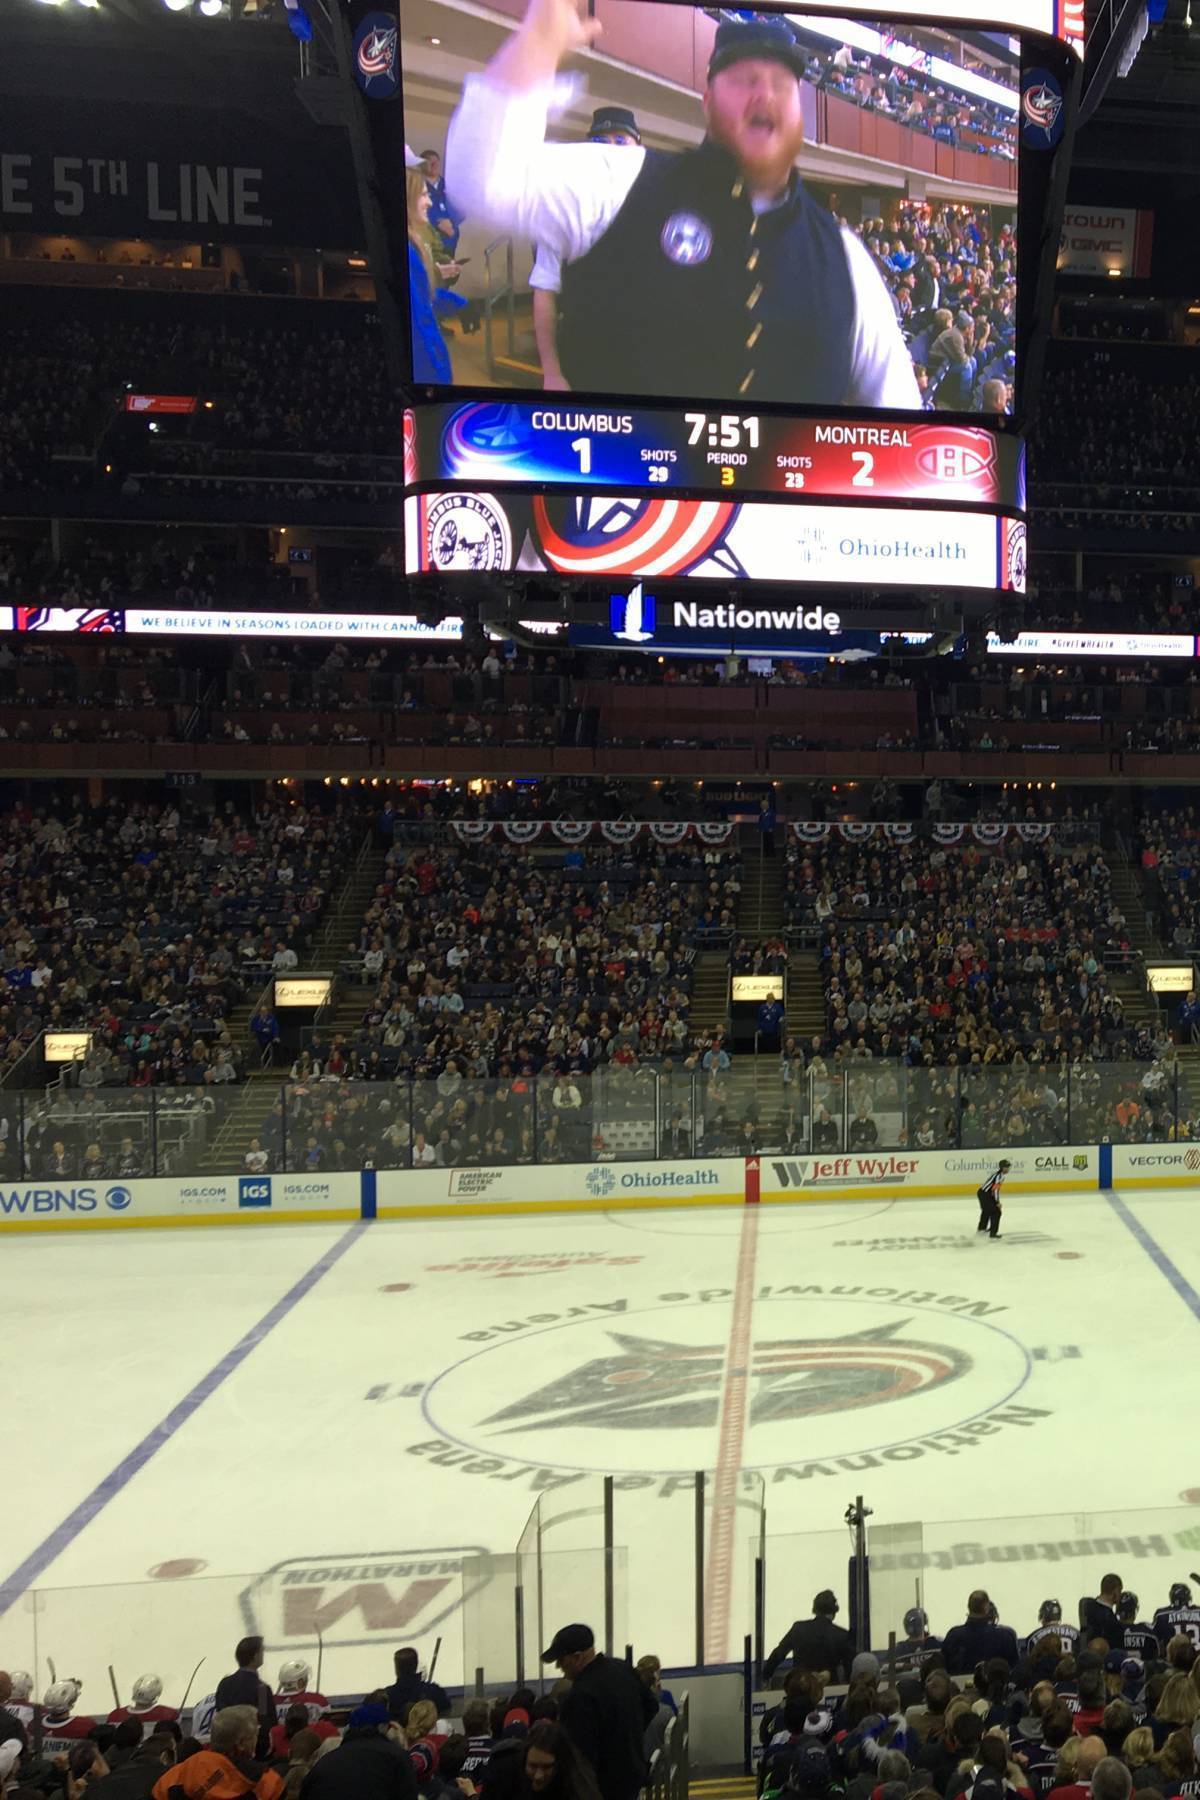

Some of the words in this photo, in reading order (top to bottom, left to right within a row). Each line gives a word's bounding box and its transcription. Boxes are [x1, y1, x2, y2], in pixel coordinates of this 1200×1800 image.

[147, 162, 264, 227] LINE
[531, 411, 633, 433] COLUMBUS
[684, 412, 760, 449] 7:51
[815, 425, 912, 448] MONTREAL
[571, 437, 592, 474] 1
[851, 450, 875, 487] 2
[640, 449, 678, 463] SHOTS
[706, 452, 748, 466] PERIOD
[776, 455, 813, 469] SHOTS
[720, 467, 736, 486] 3
[465, 497, 496, 527] BLUE
[839, 538, 967, 560] OhioHealth
[140, 616, 162, 627] WE
[164, 617, 214, 629] BELIEVE
[217, 617, 231, 628] IN
[234, 618, 291, 630] SEASONS
[294, 619, 344, 631] LOADED
[346, 620, 381, 632] WITH
[440, 623, 463, 633] FIR
[673, 601, 841, 631] Nationwide
[171, 774, 196, 786] 113
[811, 1158, 851, 1180] Jeff
[857, 1156, 919, 1182] Wyler
[1034, 1156, 1069, 1169] CALL
[1128, 1155, 1182, 1167] VECTOR
[458, 1178, 493, 1186] ELECTRIC
[459, 1171, 502, 1180] AMERICAN
[620, 1169, 719, 1188] OhioHealth
[180, 1187, 227, 1197] IGS.COM
[242, 1184, 269, 1199] IGS
[283, 1184, 330, 1195] IGS.COM
[457, 1185, 488, 1193] POWER
[0, 1187, 98, 1214] WBNS
[457, 1298, 628, 1342] Arena
[405, 1439, 587, 1491] Arena
[869, 1534, 1173, 1571] Huntington
[280, 1559, 464, 1585] MARATHON
